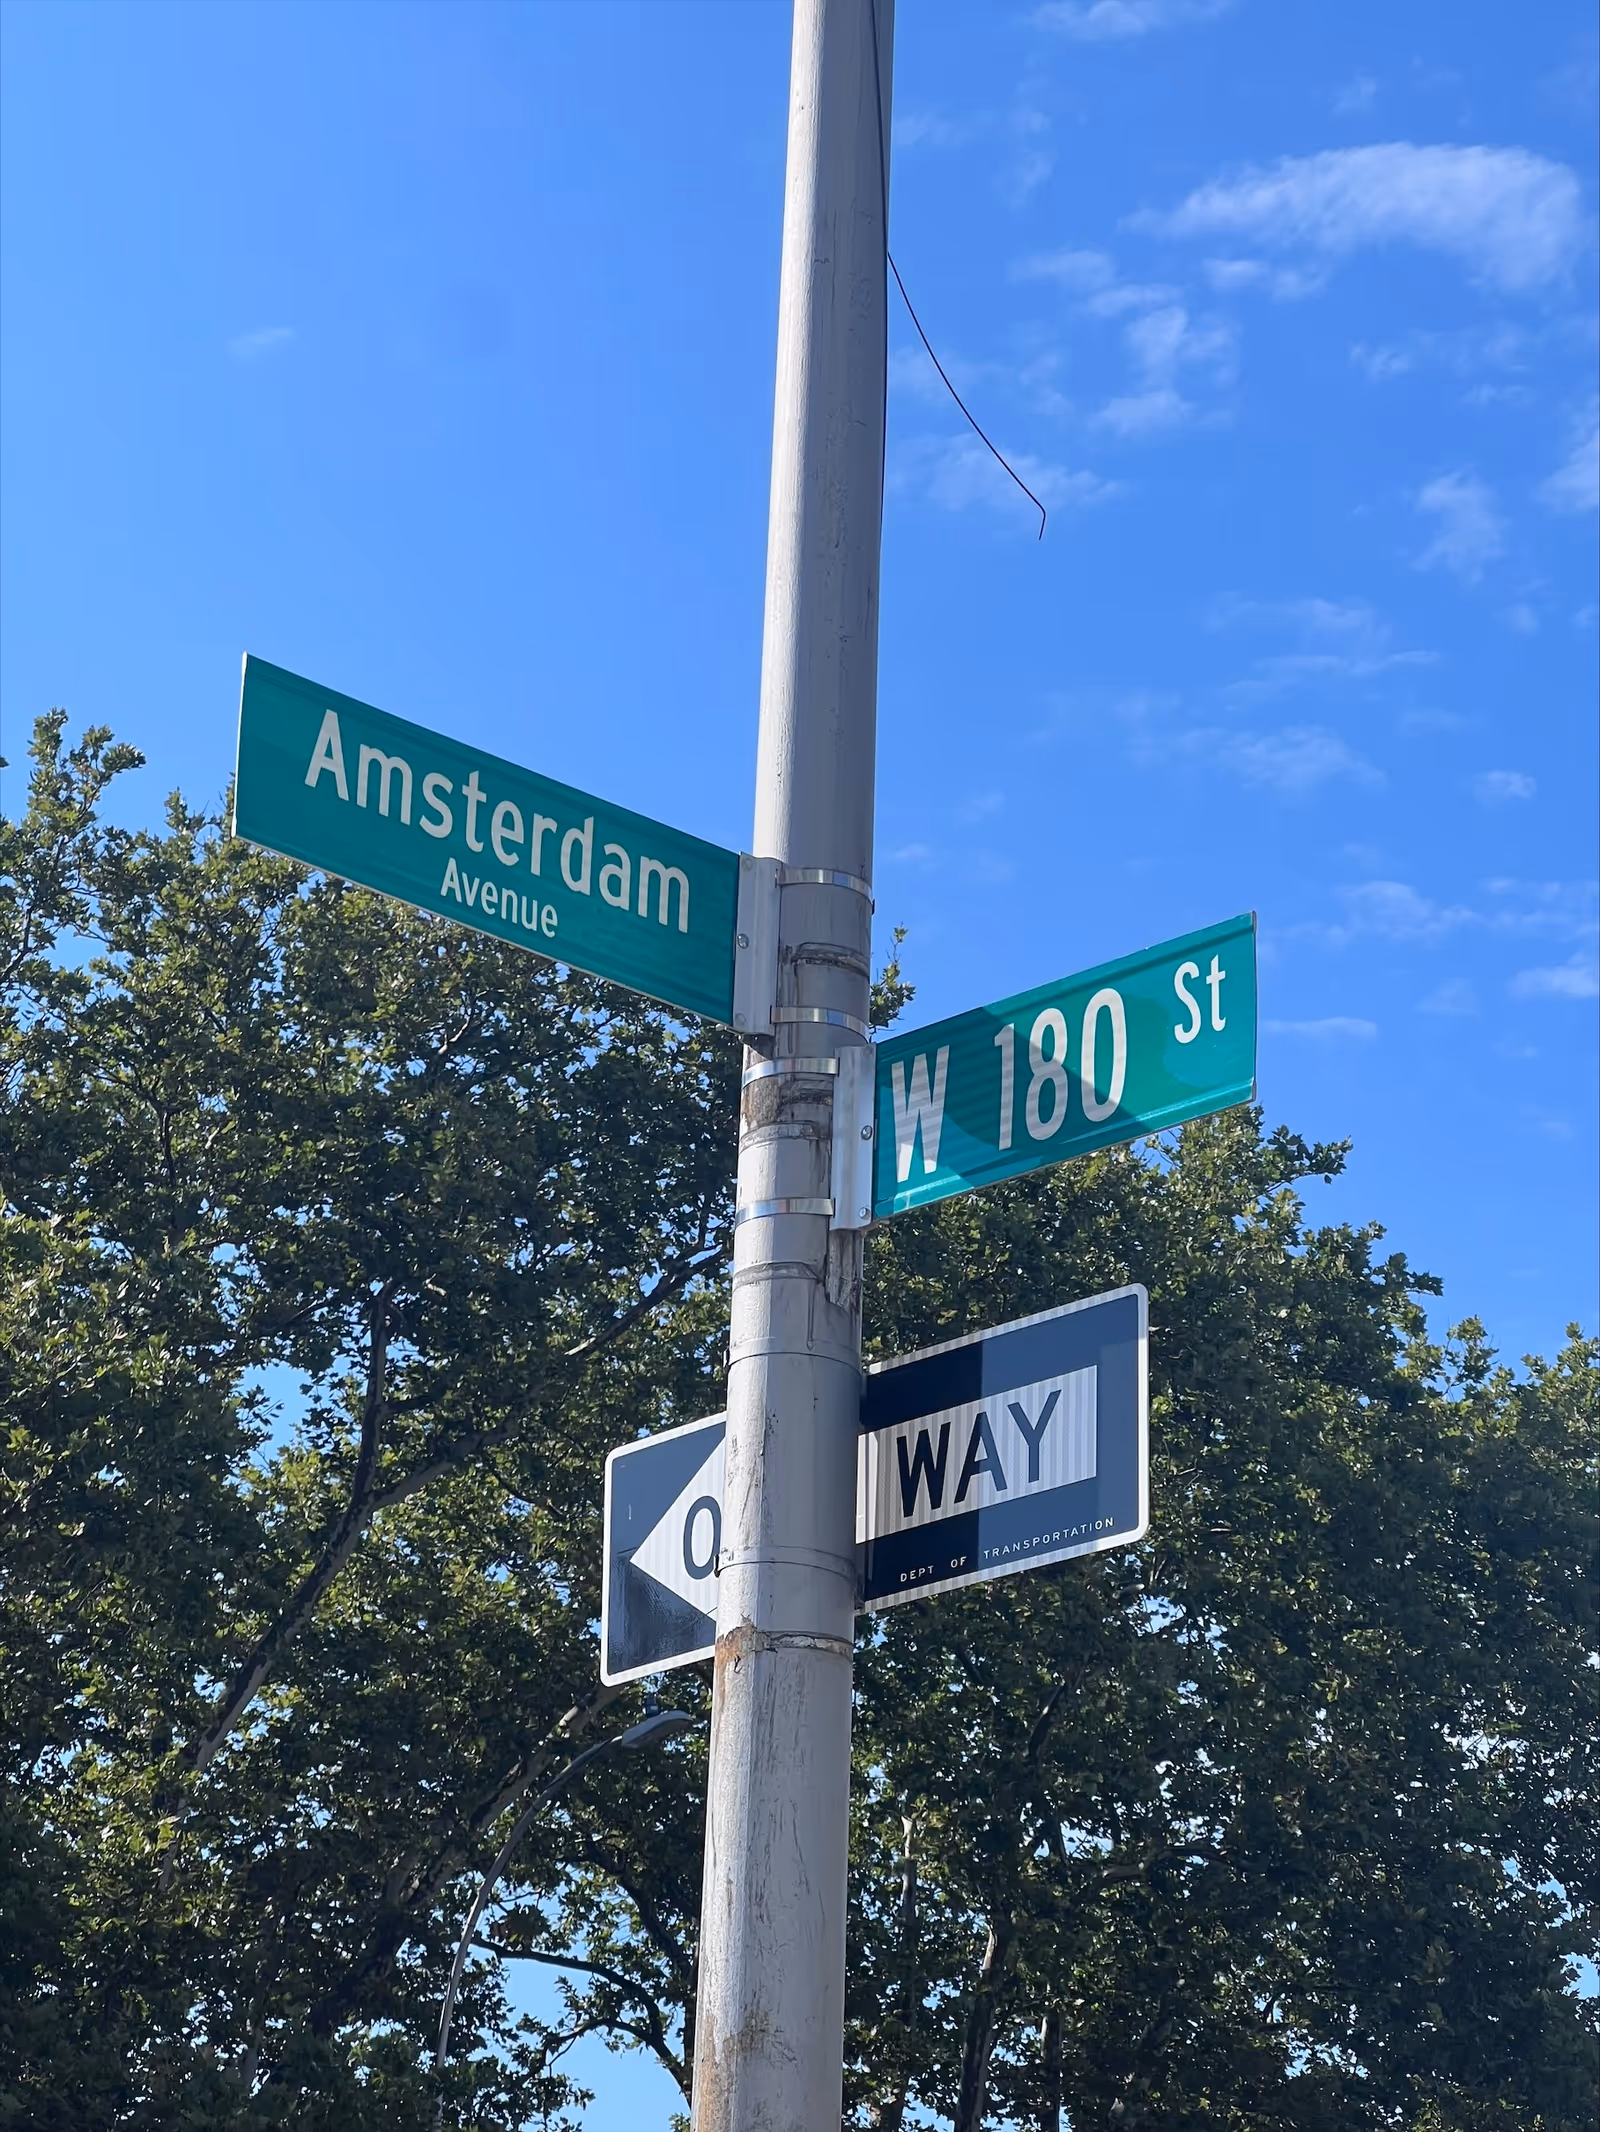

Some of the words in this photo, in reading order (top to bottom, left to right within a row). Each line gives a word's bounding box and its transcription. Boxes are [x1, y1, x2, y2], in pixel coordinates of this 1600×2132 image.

[304, 709, 690, 934] Amsterdam
[440, 857, 559, 939] Avenue
[891, 1045, 950, 1183] W
[994, 988, 1127, 1151] 180
[1173, 954, 1227, 1044] St
[896, 1390, 1062, 1518] WAY
[900, 1564, 935, 1583] DEPT
[950, 1555, 968, 1569] OF
[983, 1516, 1115, 1560] TRANSPORTATION
